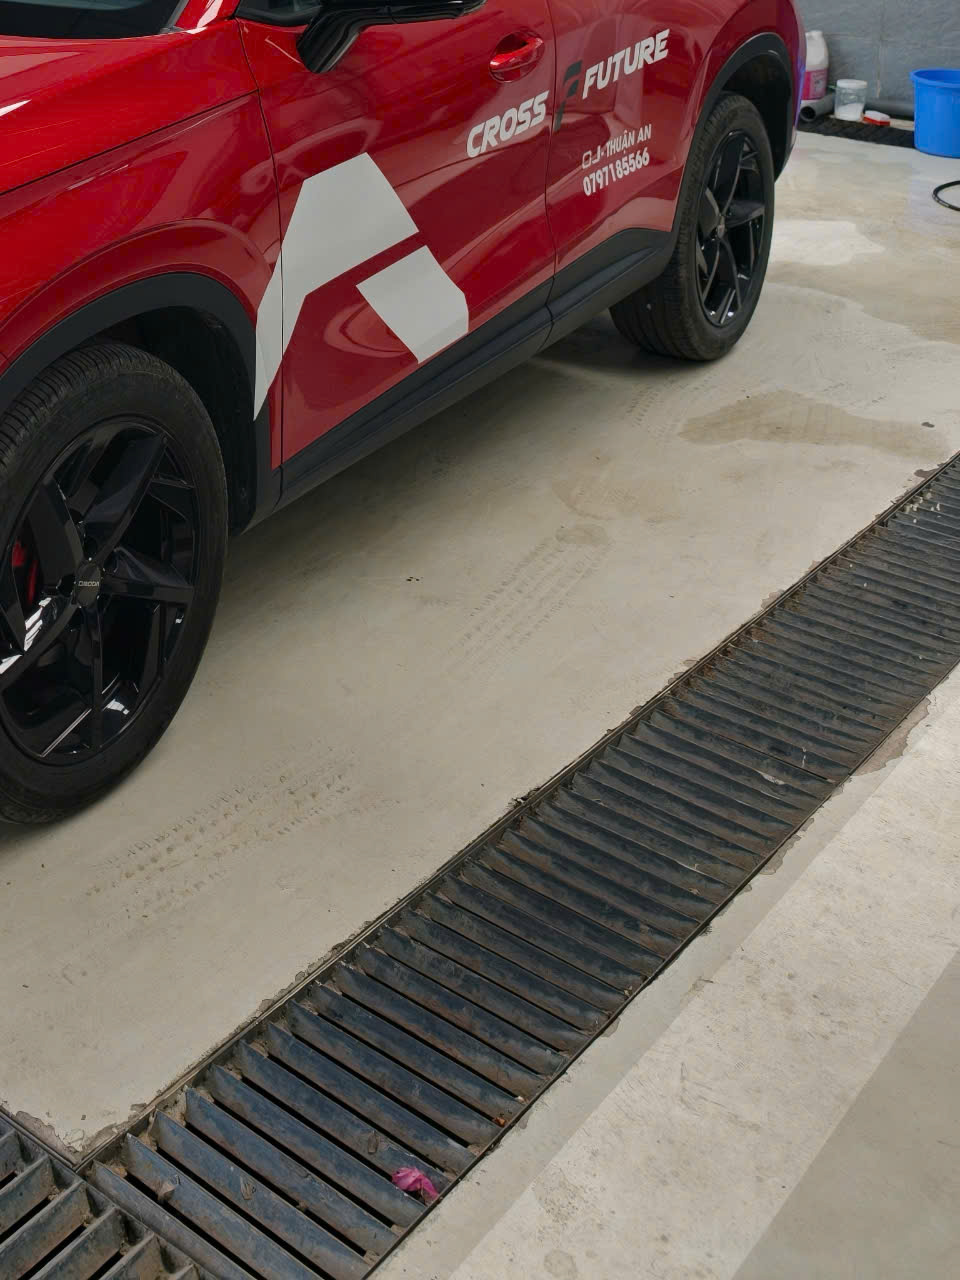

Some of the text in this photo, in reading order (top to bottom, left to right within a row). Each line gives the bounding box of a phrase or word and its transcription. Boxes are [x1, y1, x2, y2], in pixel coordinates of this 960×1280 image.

[466, 90, 549, 158] CROSS
[582, 28, 670, 100] FUTURE
[637, 124, 652, 144] AN
[583, 147, 650, 196] 0797185566
